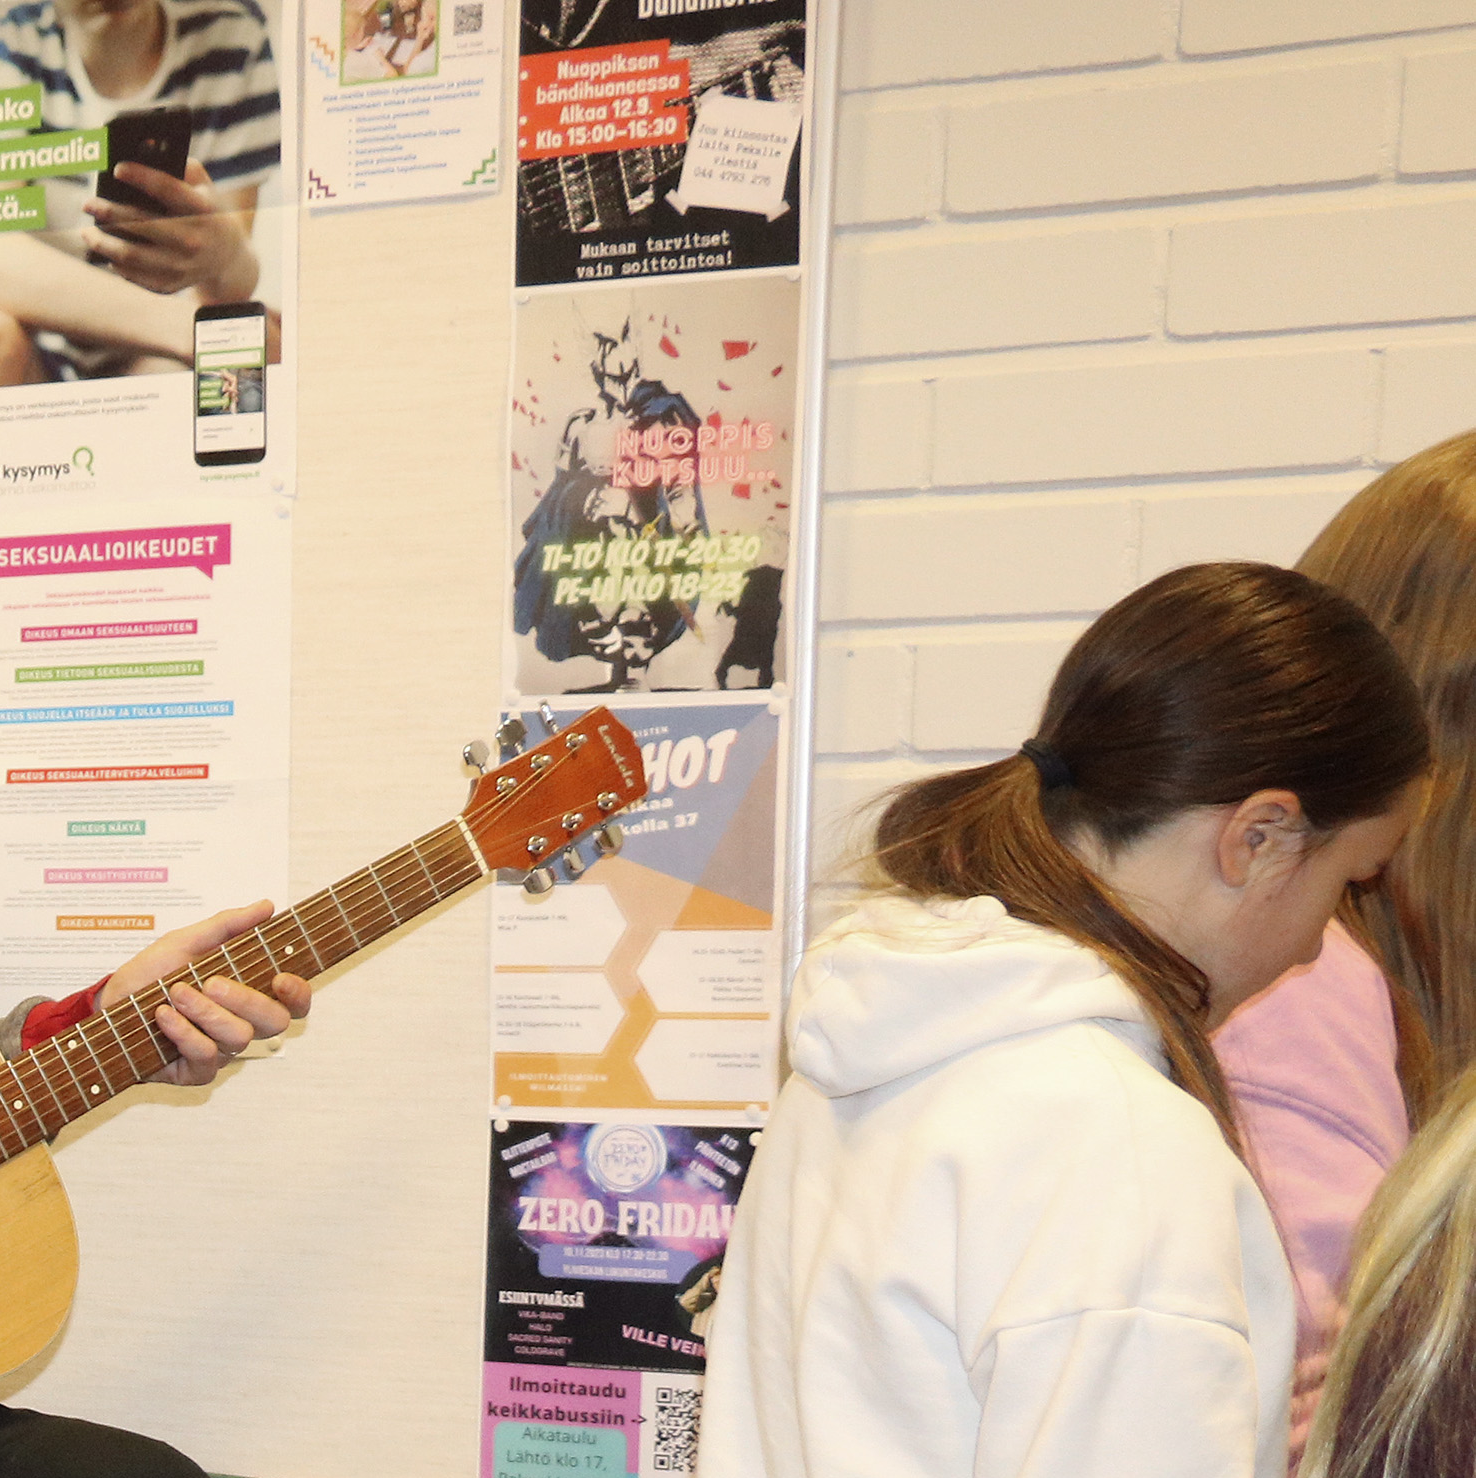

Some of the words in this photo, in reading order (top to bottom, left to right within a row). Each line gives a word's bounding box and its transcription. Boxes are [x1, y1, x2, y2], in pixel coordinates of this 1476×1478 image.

[560, 103, 607, 125] Alkaa
[536, 130, 562, 150] Klo
[580, 242, 636, 259] Mukaan
[645, 229, 731, 253] tarvitset
[575, 260, 613, 280] vain
[621, 250, 732, 277] soittointoa!
[615, 422, 775, 456] NUOPPIS
[3, 462, 70, 483] kysymys
[612, 455, 776, 488] KUTSUU...
[25, 629, 59, 640] OIKEUS
[60, 627, 94, 637] OMAAN
[19, 669, 53, 680] OIKEUS
[132, 706, 162, 716] TULLA
[642, 728, 738, 793] HOT
[10, 771, 45, 781] OIKEUS
[71, 823, 106, 833] OIKEUS
[620, 818, 669, 836] kolla
[674, 812, 699, 828] 37
[48, 871, 83, 880] OIKEUS
[60, 918, 95, 927] OIKEUS
[517, 1195, 605, 1234] ZERO
[622, 1324, 669, 1349] VILLE
[509, 1376, 627, 1399] Ilmoittaudu
[487, 1401, 625, 1426] keikkabussiin
[521, 1427, 597, 1445] Aikataulu
[556, 1453, 579, 1469] klo
